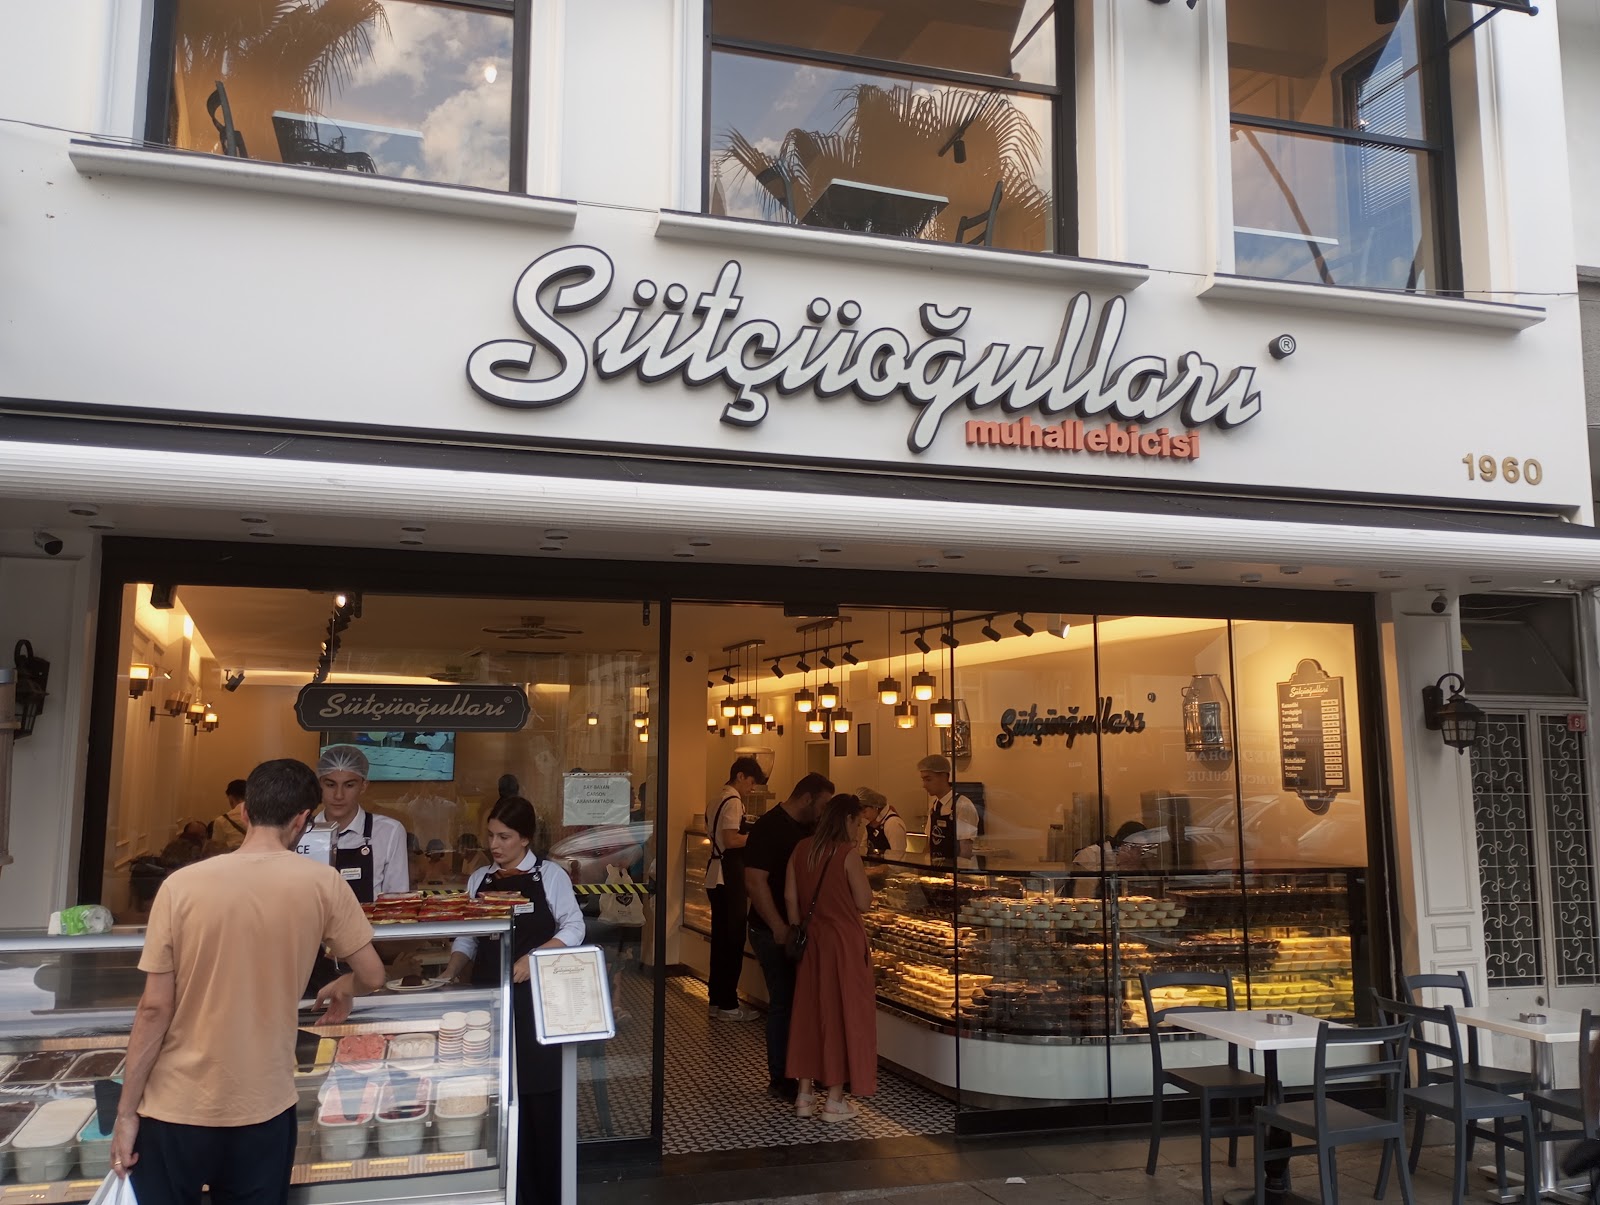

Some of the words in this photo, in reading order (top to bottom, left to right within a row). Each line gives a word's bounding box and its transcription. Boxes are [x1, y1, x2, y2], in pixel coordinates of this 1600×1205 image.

[466, 245, 1262, 453] Sütçüoğulları
[965, 416, 1200, 460] muhallebicisi
[1462, 453, 1543, 486] 1960
[319, 693, 506, 724] Sütçüoğulları
